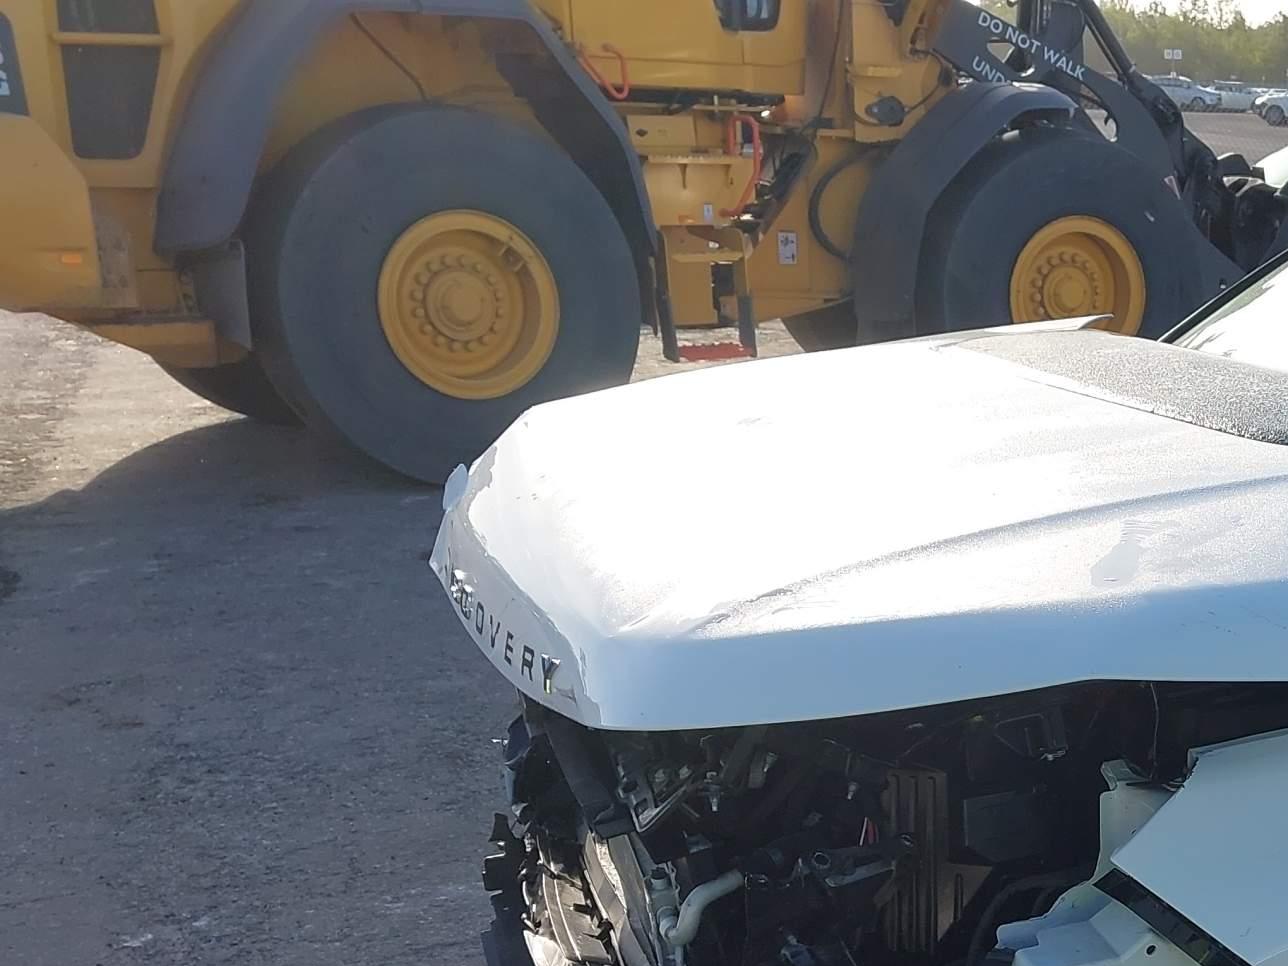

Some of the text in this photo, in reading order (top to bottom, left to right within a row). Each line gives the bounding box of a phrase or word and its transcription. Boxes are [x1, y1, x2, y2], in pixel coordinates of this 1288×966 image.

[972, 55, 1011, 84] UND
[978, 11, 1086, 81] DO NOT WALK
